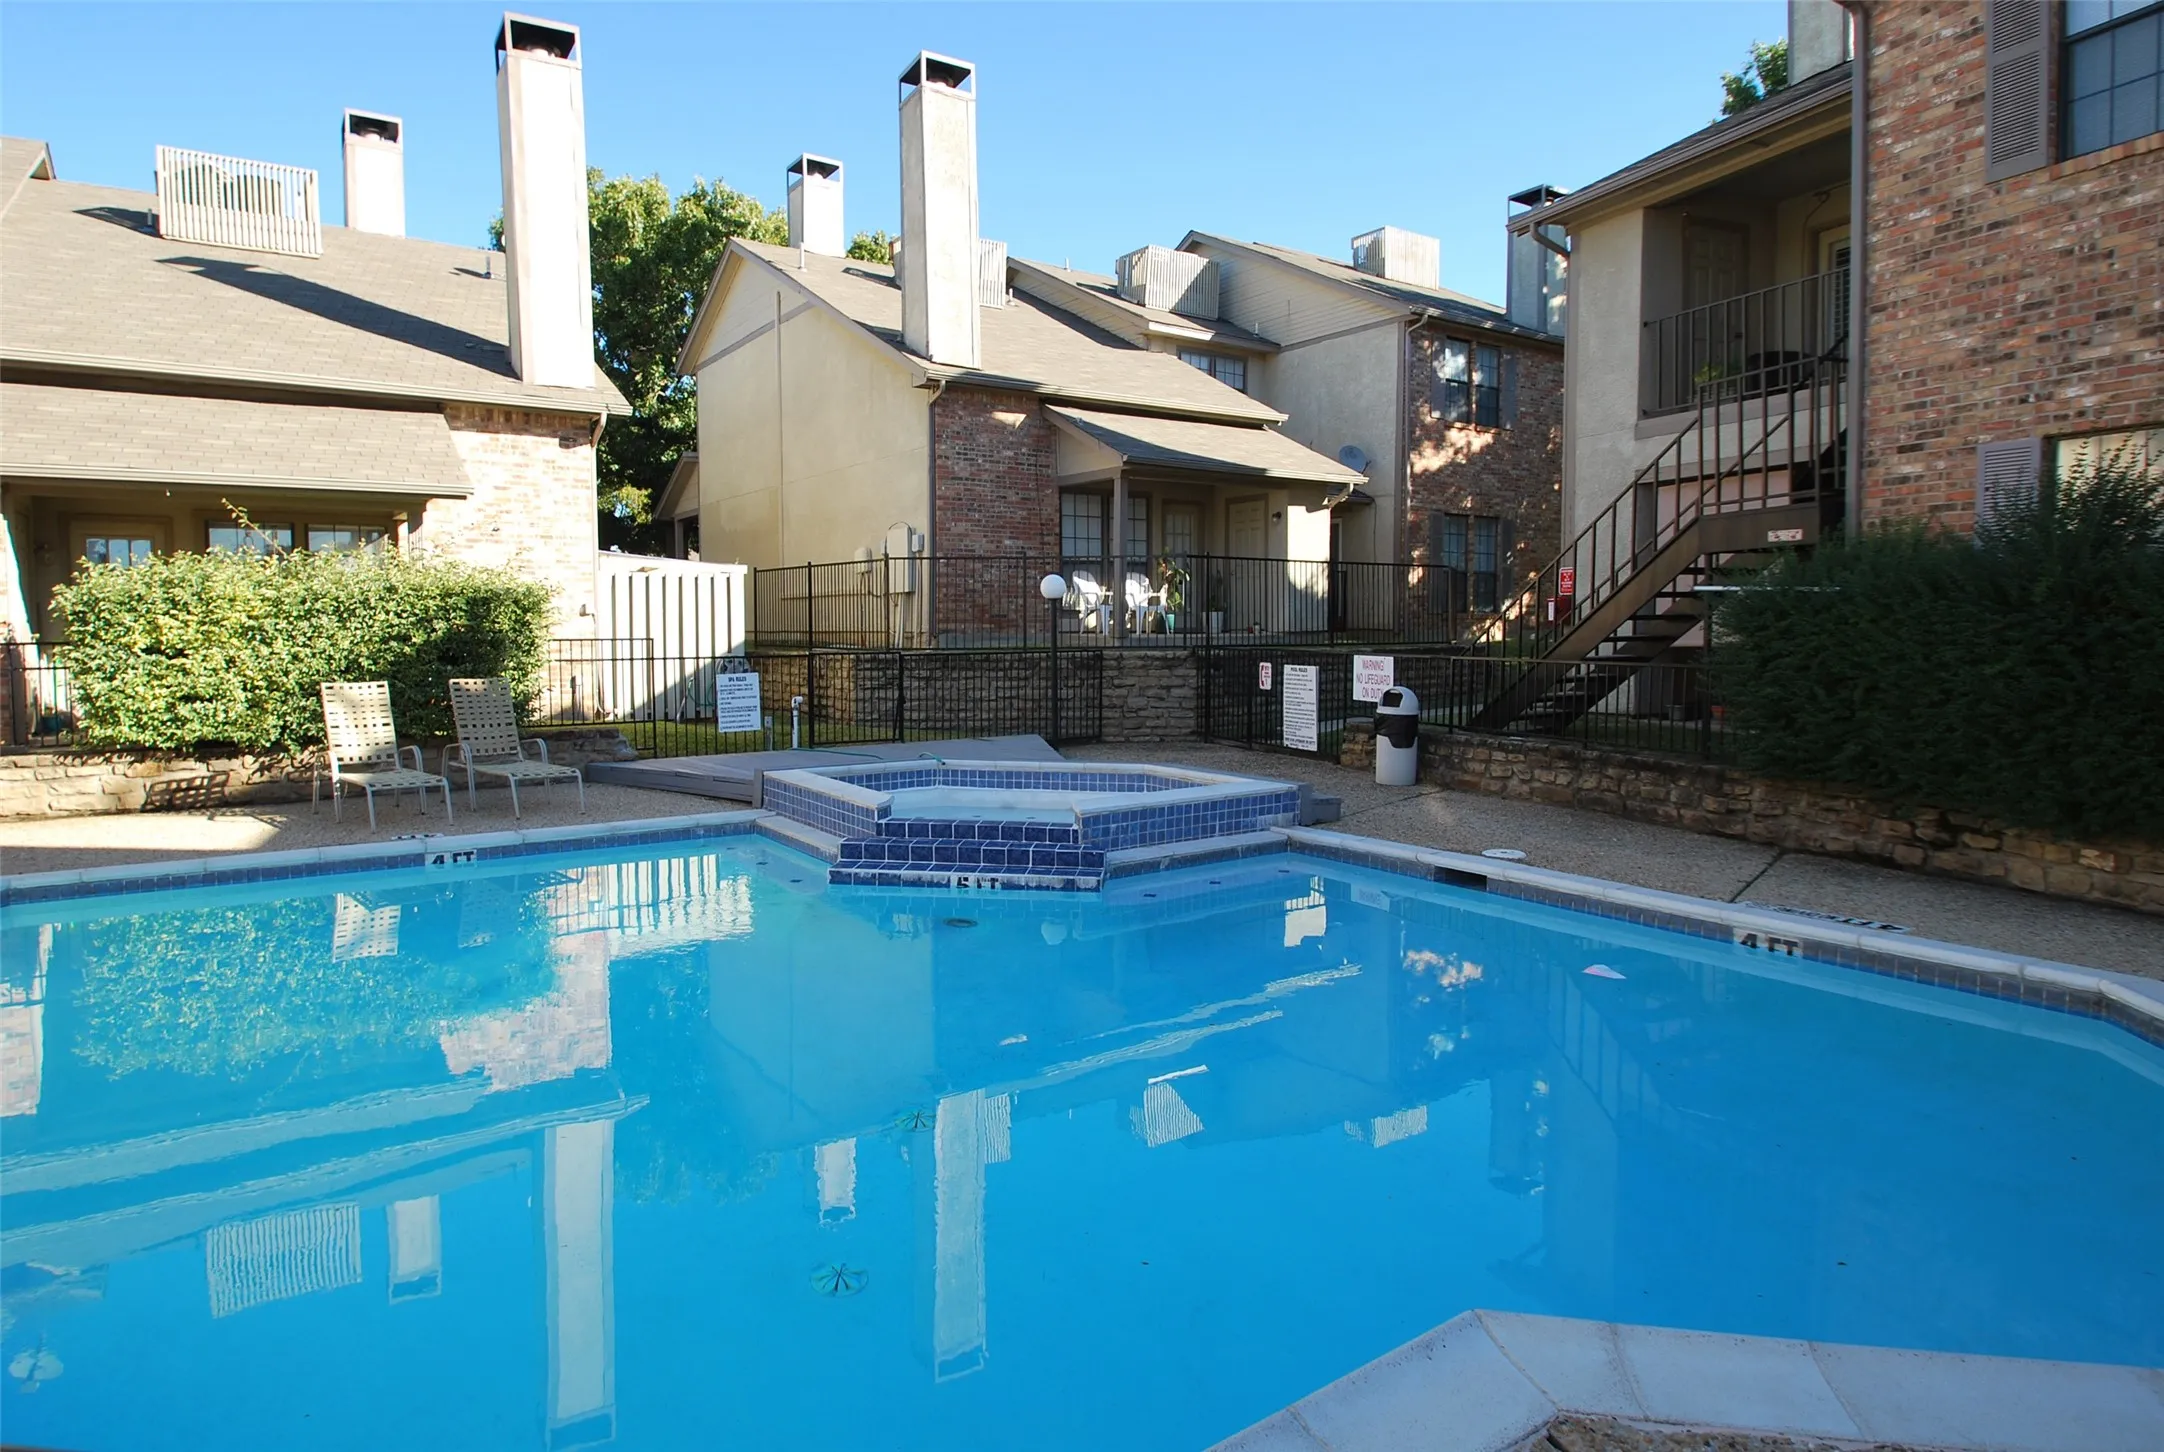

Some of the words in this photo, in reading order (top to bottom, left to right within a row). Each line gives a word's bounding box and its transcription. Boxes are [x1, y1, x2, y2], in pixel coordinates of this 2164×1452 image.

[1362, 660, 1384, 671] WARNING
[1356, 673, 1363, 684] NO
[1364, 673, 1390, 686] LIFEGUARD
[1361, 687, 1369, 698] ON
[431, 854, 445, 865] 4
[1740, 932, 1759, 949] 4
